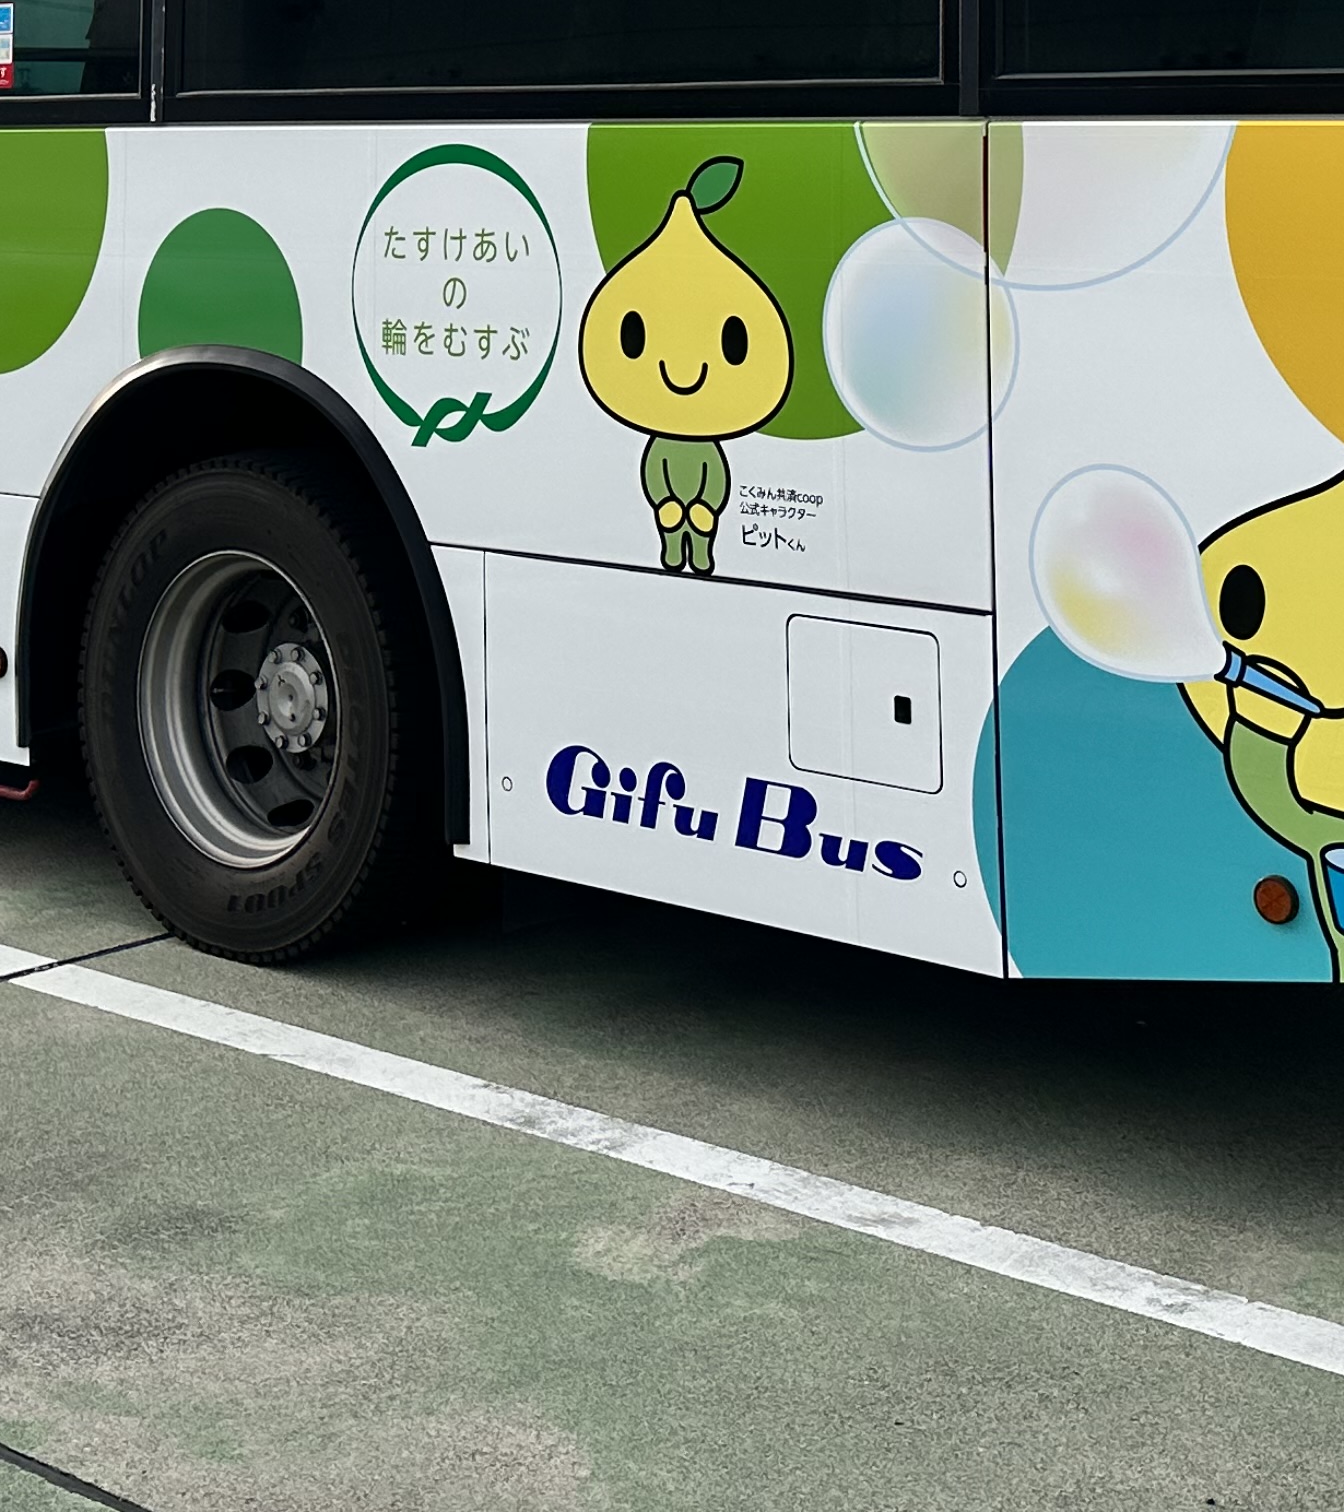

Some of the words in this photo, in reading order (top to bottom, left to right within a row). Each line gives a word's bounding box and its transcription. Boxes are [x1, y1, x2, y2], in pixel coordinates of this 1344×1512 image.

[382, 225, 531, 265] たすけあい
[442, 276, 467, 309] の
[381, 318, 531, 362] 輪をむすぶ
[739, 485, 824, 507] こくみん共済coop
[739, 501, 817, 520] 公式キャラクター
[741, 522, 806, 553] ピットくん
[546, 744, 719, 841] Gifu
[734, 776, 924, 881] Bus
